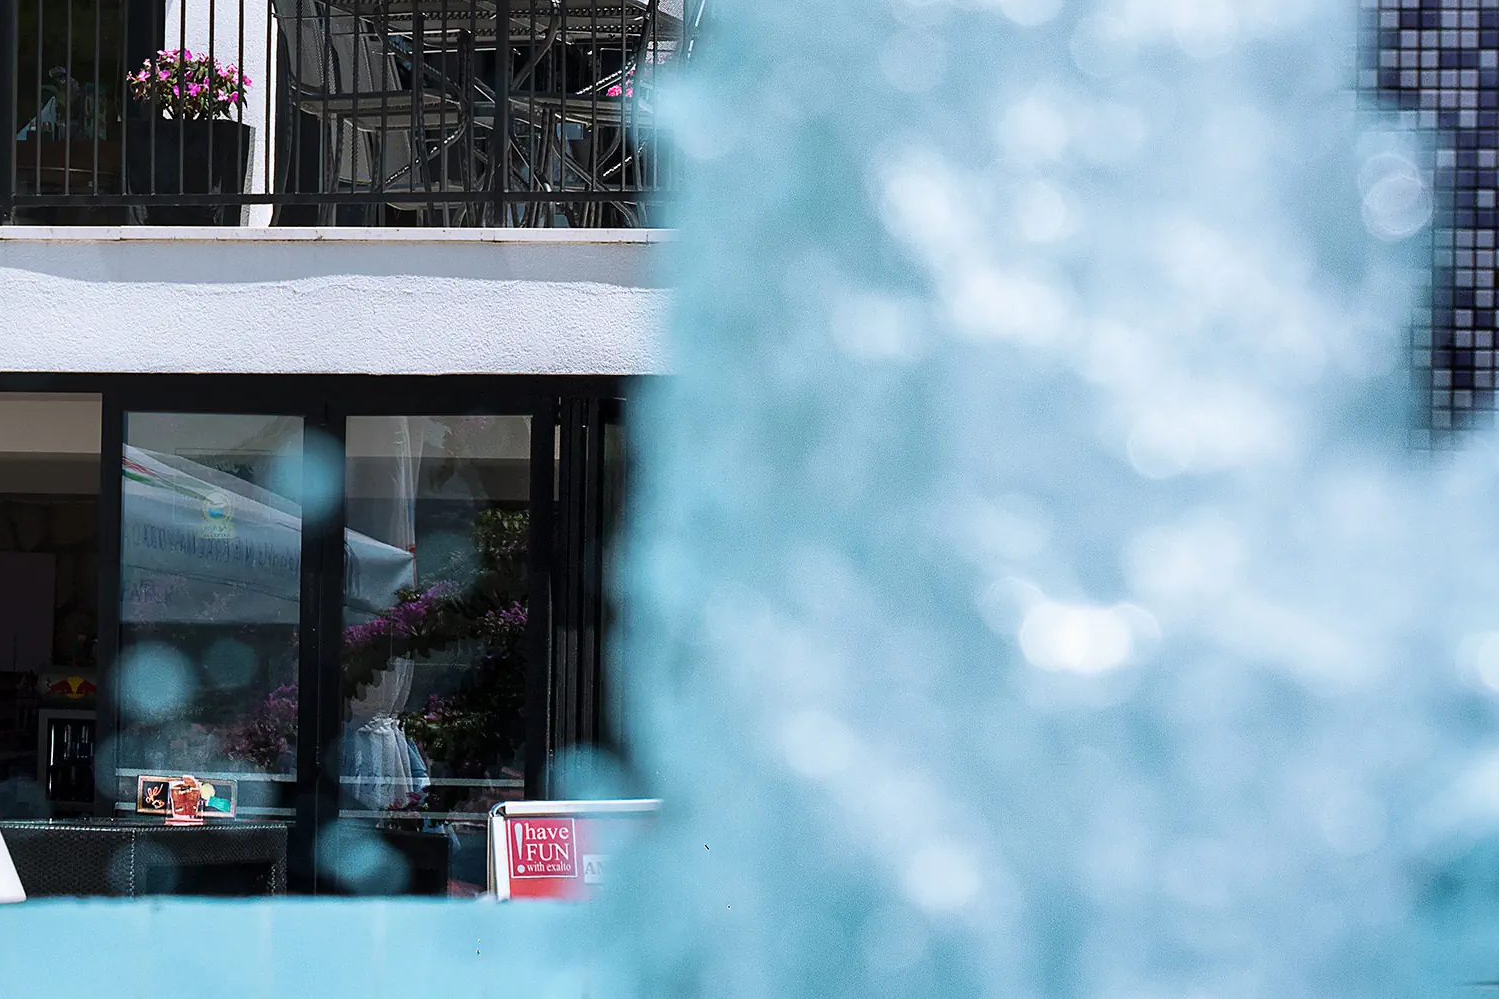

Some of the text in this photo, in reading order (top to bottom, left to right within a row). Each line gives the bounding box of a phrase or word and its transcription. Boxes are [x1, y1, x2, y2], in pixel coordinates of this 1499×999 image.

[525, 822, 569, 840] have
[526, 843, 569, 861] FUN
[527, 861, 571, 872] with exalto
